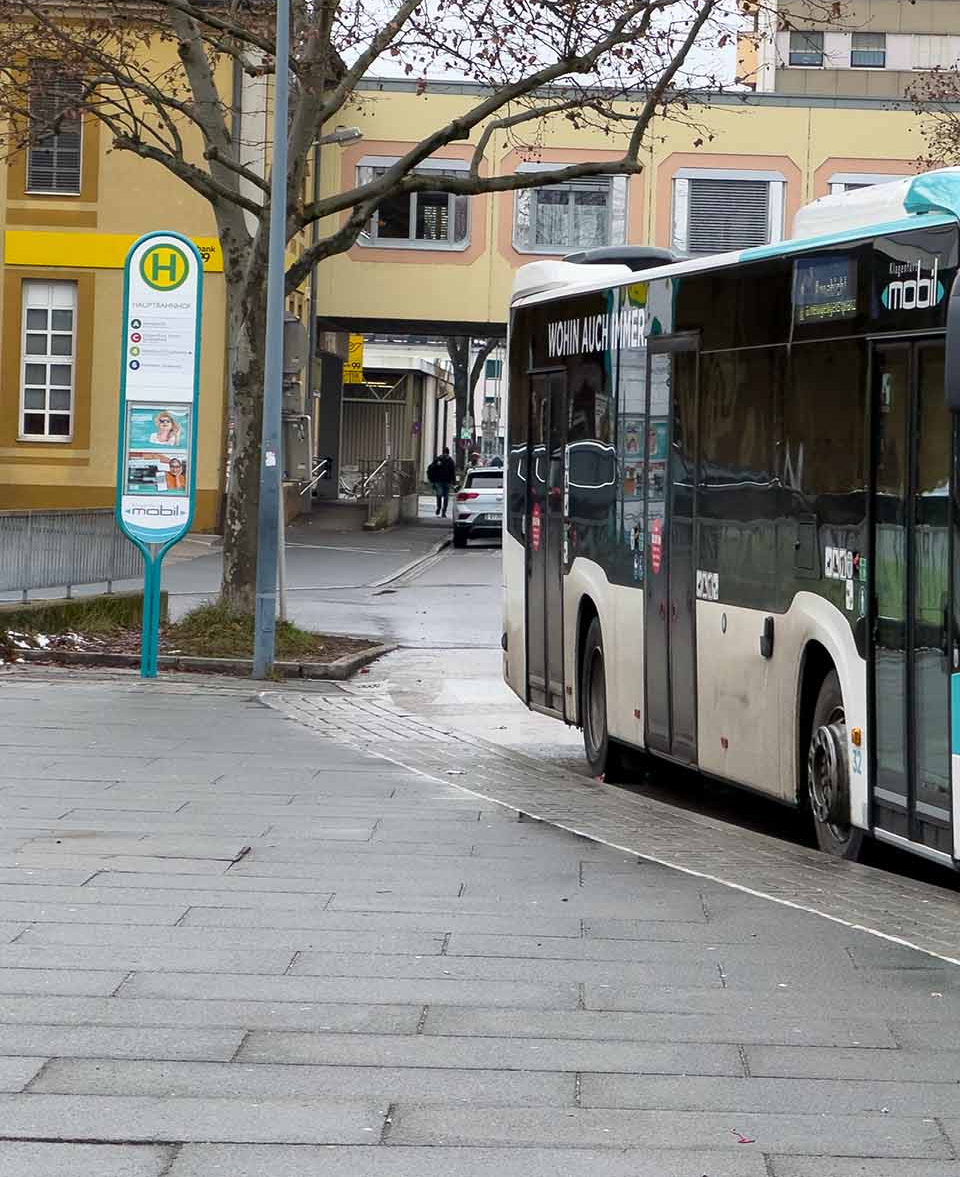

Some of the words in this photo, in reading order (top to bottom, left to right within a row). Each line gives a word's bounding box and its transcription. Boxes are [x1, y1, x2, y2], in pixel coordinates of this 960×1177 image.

[152, 253, 176, 282] H
[888, 257, 938, 310] mobil
[548, 318, 580, 358] WOHIN
[581, 313, 609, 354] AUCH
[611, 308, 648, 350] IMMER.
[132, 503, 179, 516] mobil
